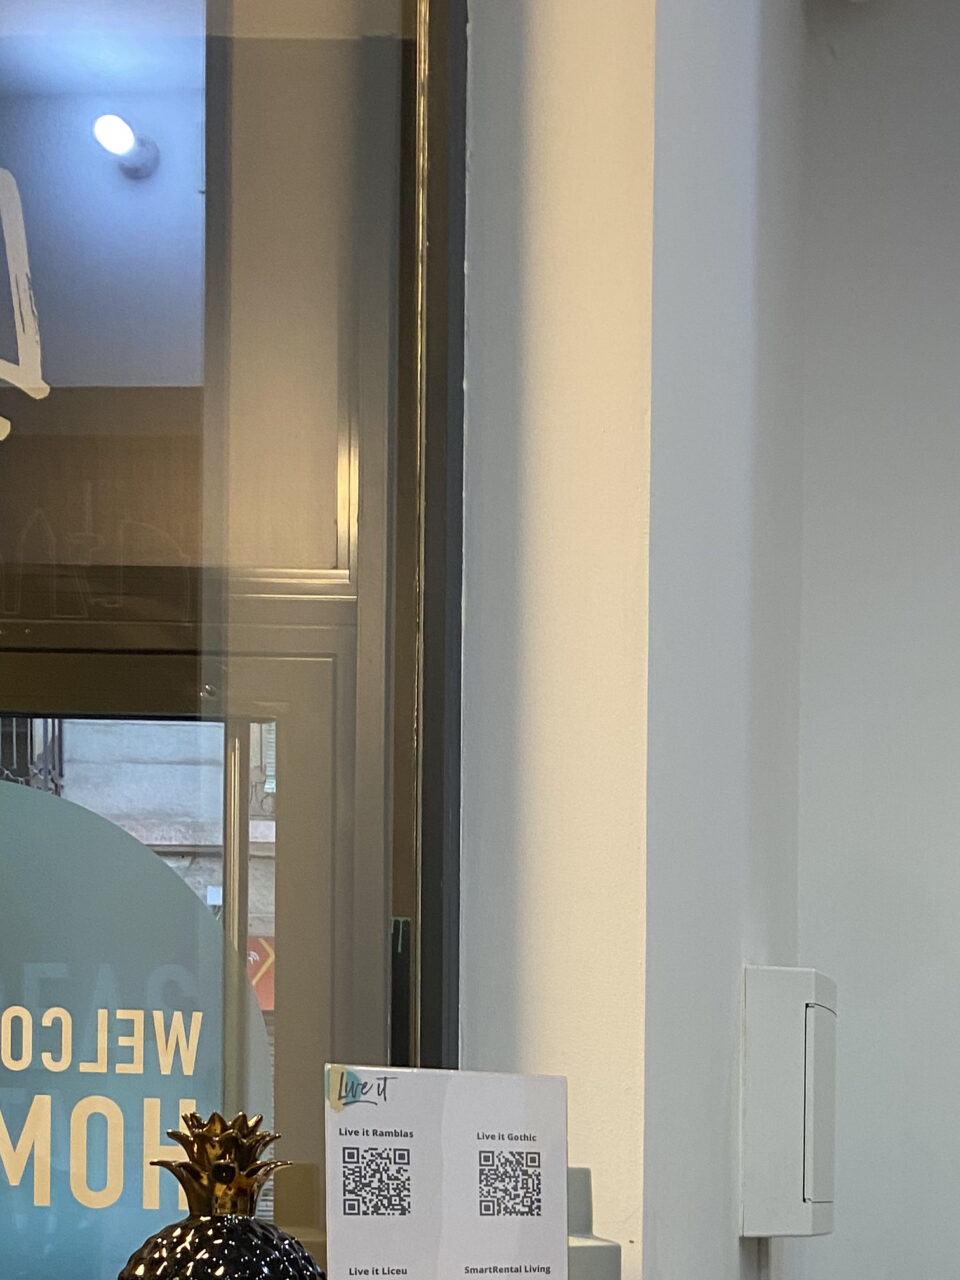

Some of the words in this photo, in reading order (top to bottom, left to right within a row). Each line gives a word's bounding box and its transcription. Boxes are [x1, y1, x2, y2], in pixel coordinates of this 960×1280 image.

[337, 1070, 374, 1101] Live
[376, 1076, 398, 1101] it
[338, 1127, 359, 1138] Live
[362, 1128, 370, 1138] it
[372, 1128, 414, 1139] Ramblas
[476, 1131, 496, 1141] Live
[498, 1132, 506, 1141] it
[507, 1132, 537, 1142] Gothic
[348, 1266, 370, 1276] Live
[372, 1266, 380, 1276] it
[381, 1266, 408, 1276] Liceu
[464, 1265, 523, 1274] SmartRental
[523, 1264, 551, 1275] Living
